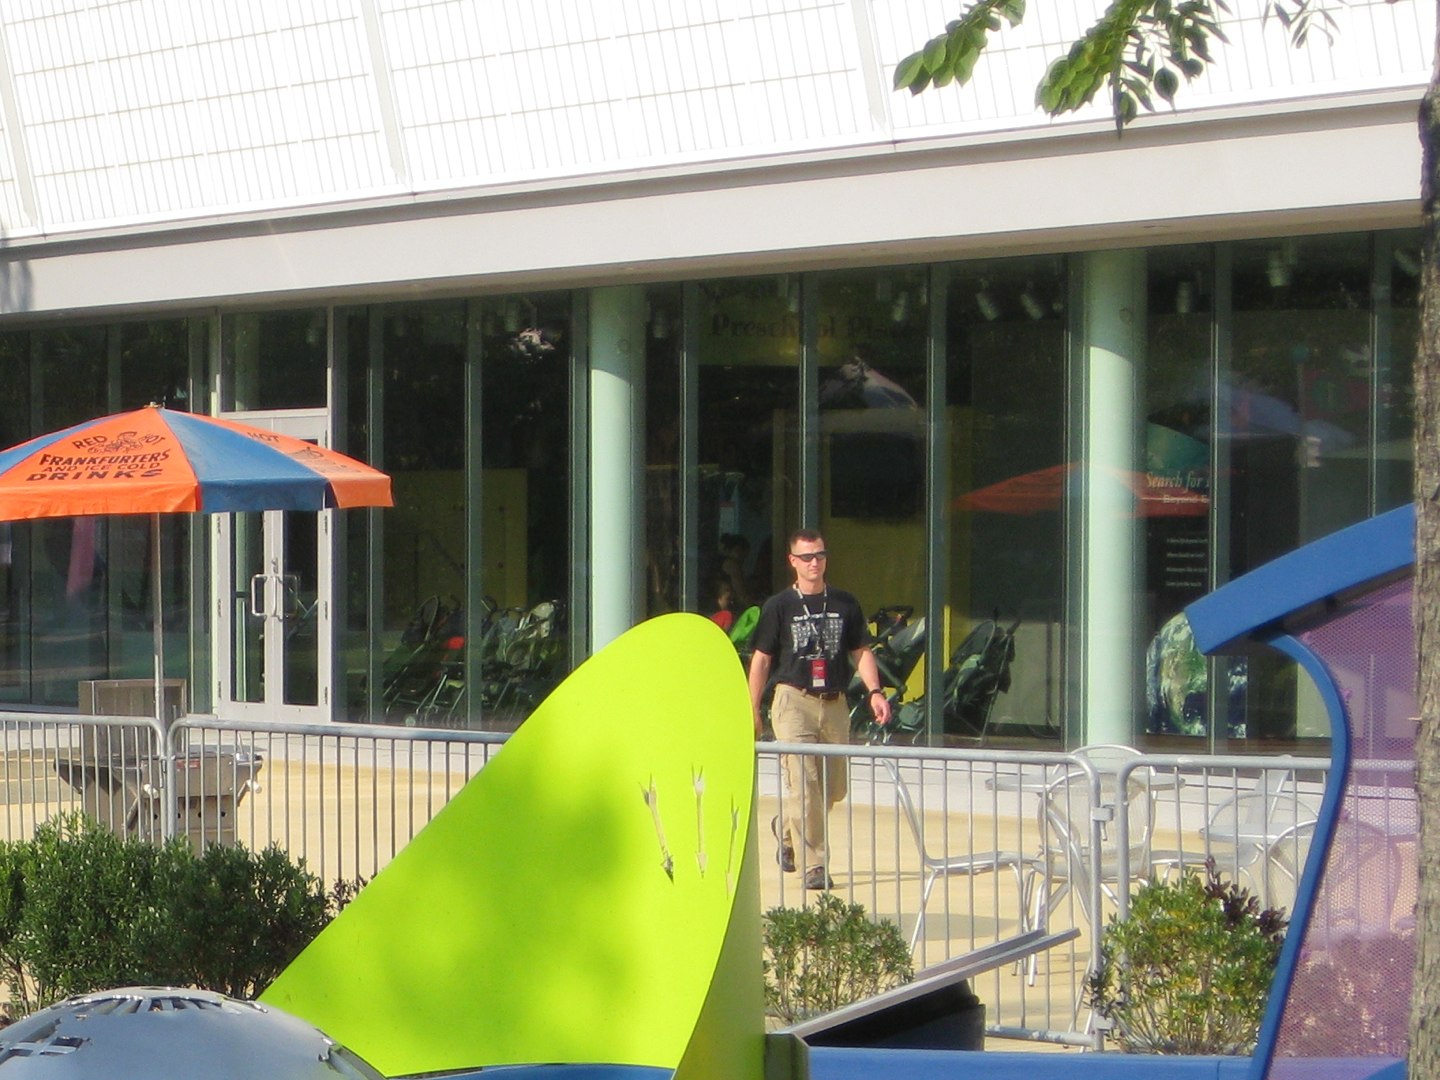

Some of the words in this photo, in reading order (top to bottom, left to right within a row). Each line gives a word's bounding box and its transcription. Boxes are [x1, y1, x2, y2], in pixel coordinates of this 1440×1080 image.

[711, 312, 835, 337] Preschol
[72, 435, 108, 449] RED
[39, 448, 171, 466] FRANKFURTERS
[118, 462, 161, 470] COLD
[25, 469, 164, 482] DRINKS
[1146, 471, 1183, 488] Search
[1183, 470, 1203, 494] for
